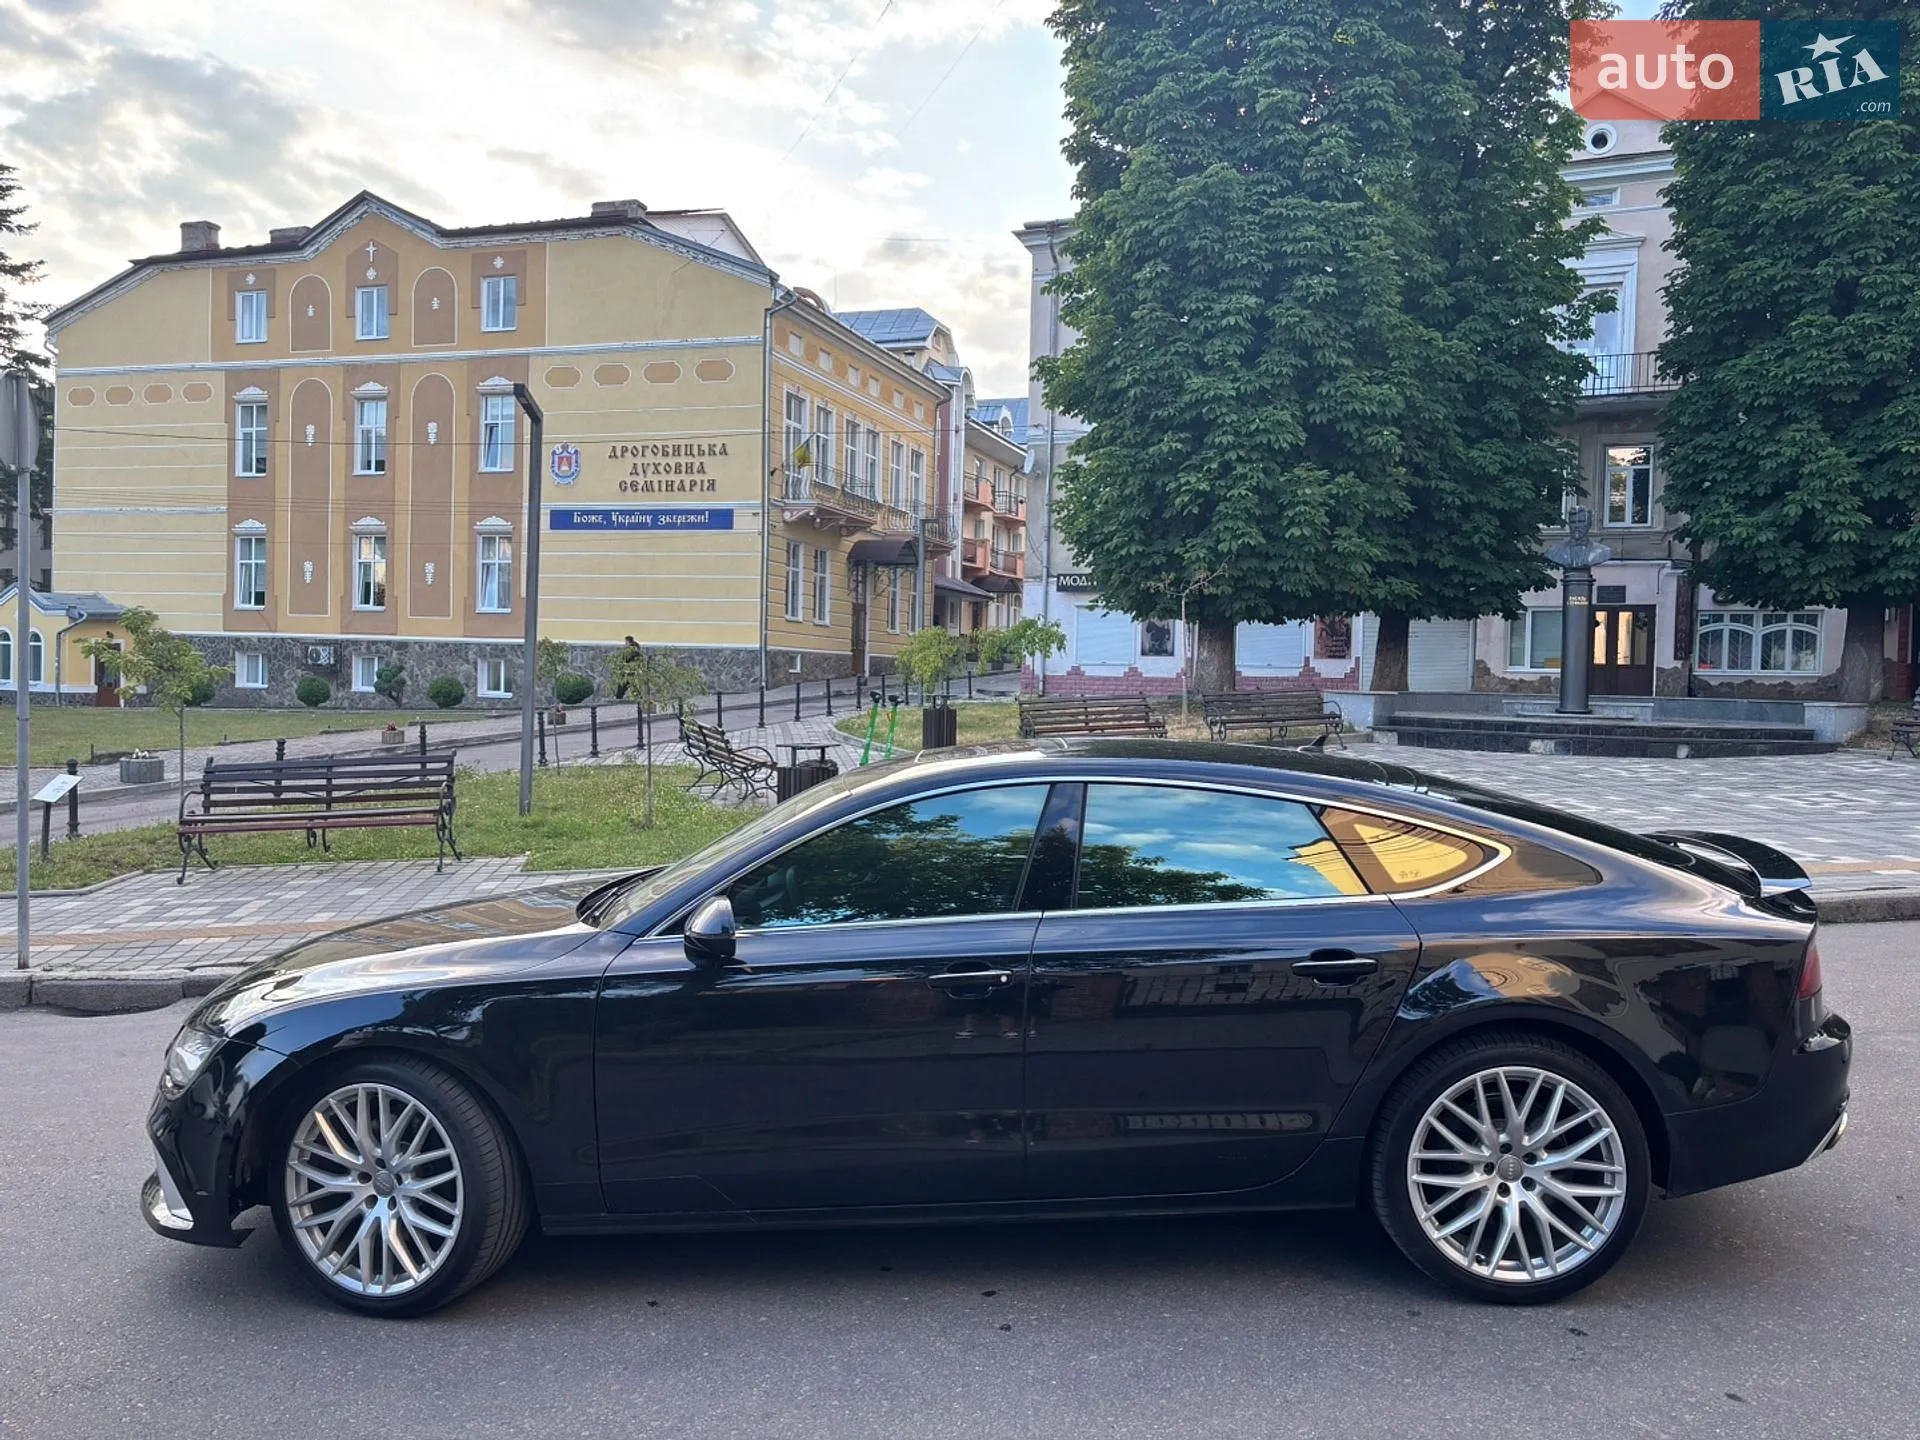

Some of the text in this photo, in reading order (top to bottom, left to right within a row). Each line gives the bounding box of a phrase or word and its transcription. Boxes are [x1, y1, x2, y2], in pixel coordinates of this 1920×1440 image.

[608, 443, 728, 459] ДРОГОБИЦЬКА
[629, 461, 707, 478] ДУХОВНА
[573, 511, 607, 525] Боже,
[1058, 575, 1097, 587] МОД
